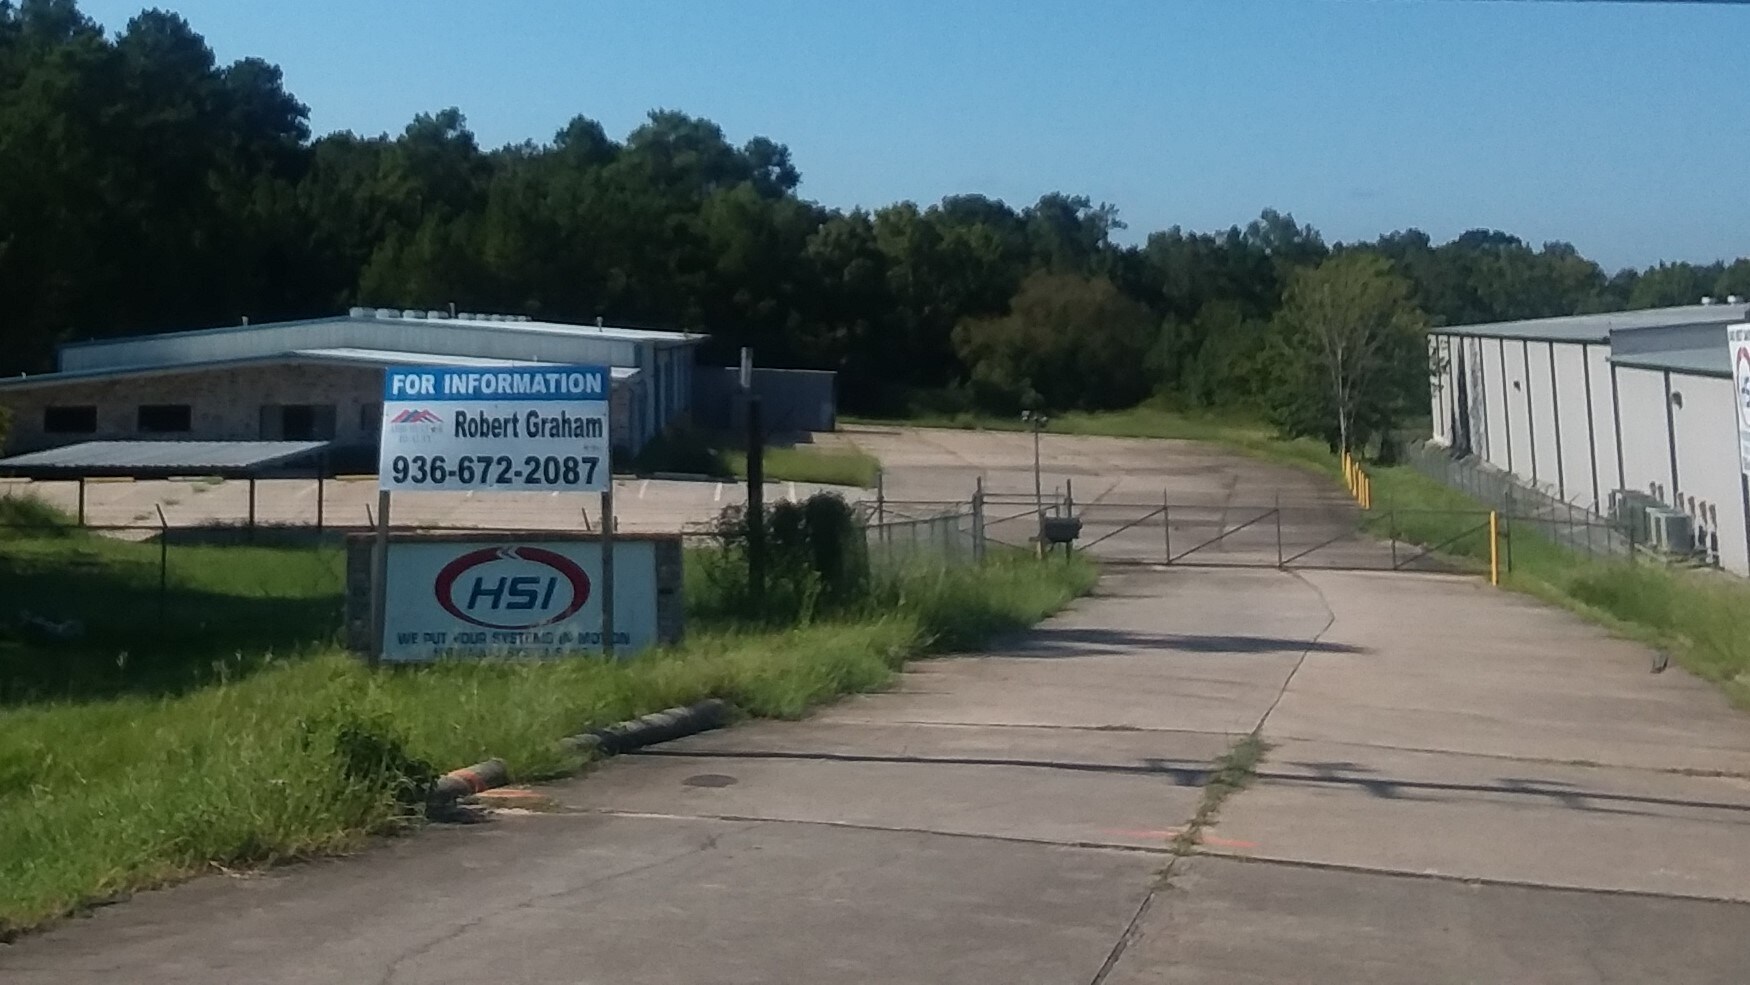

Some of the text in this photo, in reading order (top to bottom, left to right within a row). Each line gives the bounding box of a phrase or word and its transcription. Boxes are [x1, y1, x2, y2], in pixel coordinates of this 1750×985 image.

[392, 373, 602, 395] FOR INFORMATION
[454, 410, 603, 438] Robert Graham
[392, 456, 600, 484] 936-672-2087
[467, 576, 558, 610] HSI
[397, 632, 418, 645] WE
[424, 632, 447, 645] PUT
[578, 631, 630, 645] MOON
